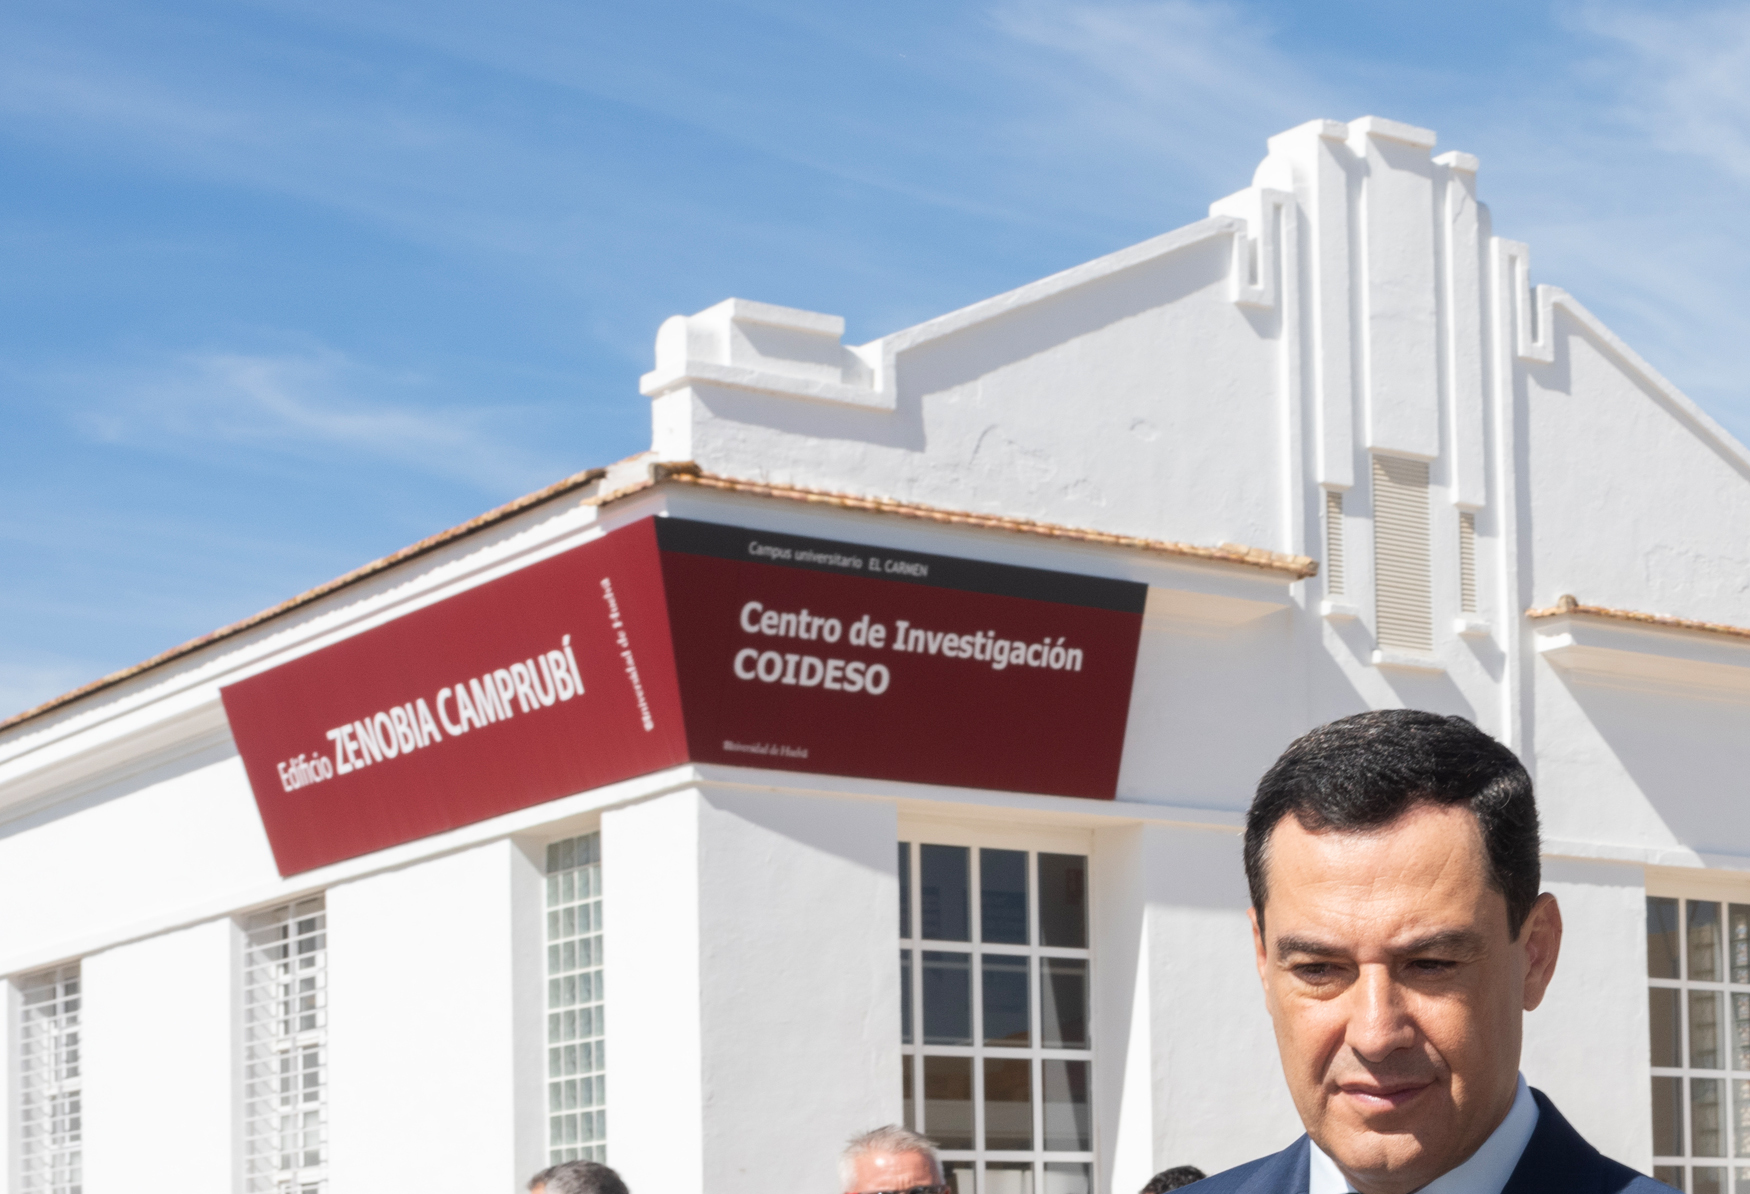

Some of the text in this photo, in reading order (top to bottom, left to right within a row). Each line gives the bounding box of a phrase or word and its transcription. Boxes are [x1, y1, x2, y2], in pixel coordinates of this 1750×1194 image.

[749, 541, 929, 578] Campus universitario EL CARMEN
[740, 601, 1084, 672] Centro de Investigación
[733, 648, 890, 695] COIDESO
[277, 634, 585, 792] Edificio ZENOBIA CAMPRUBÍ
